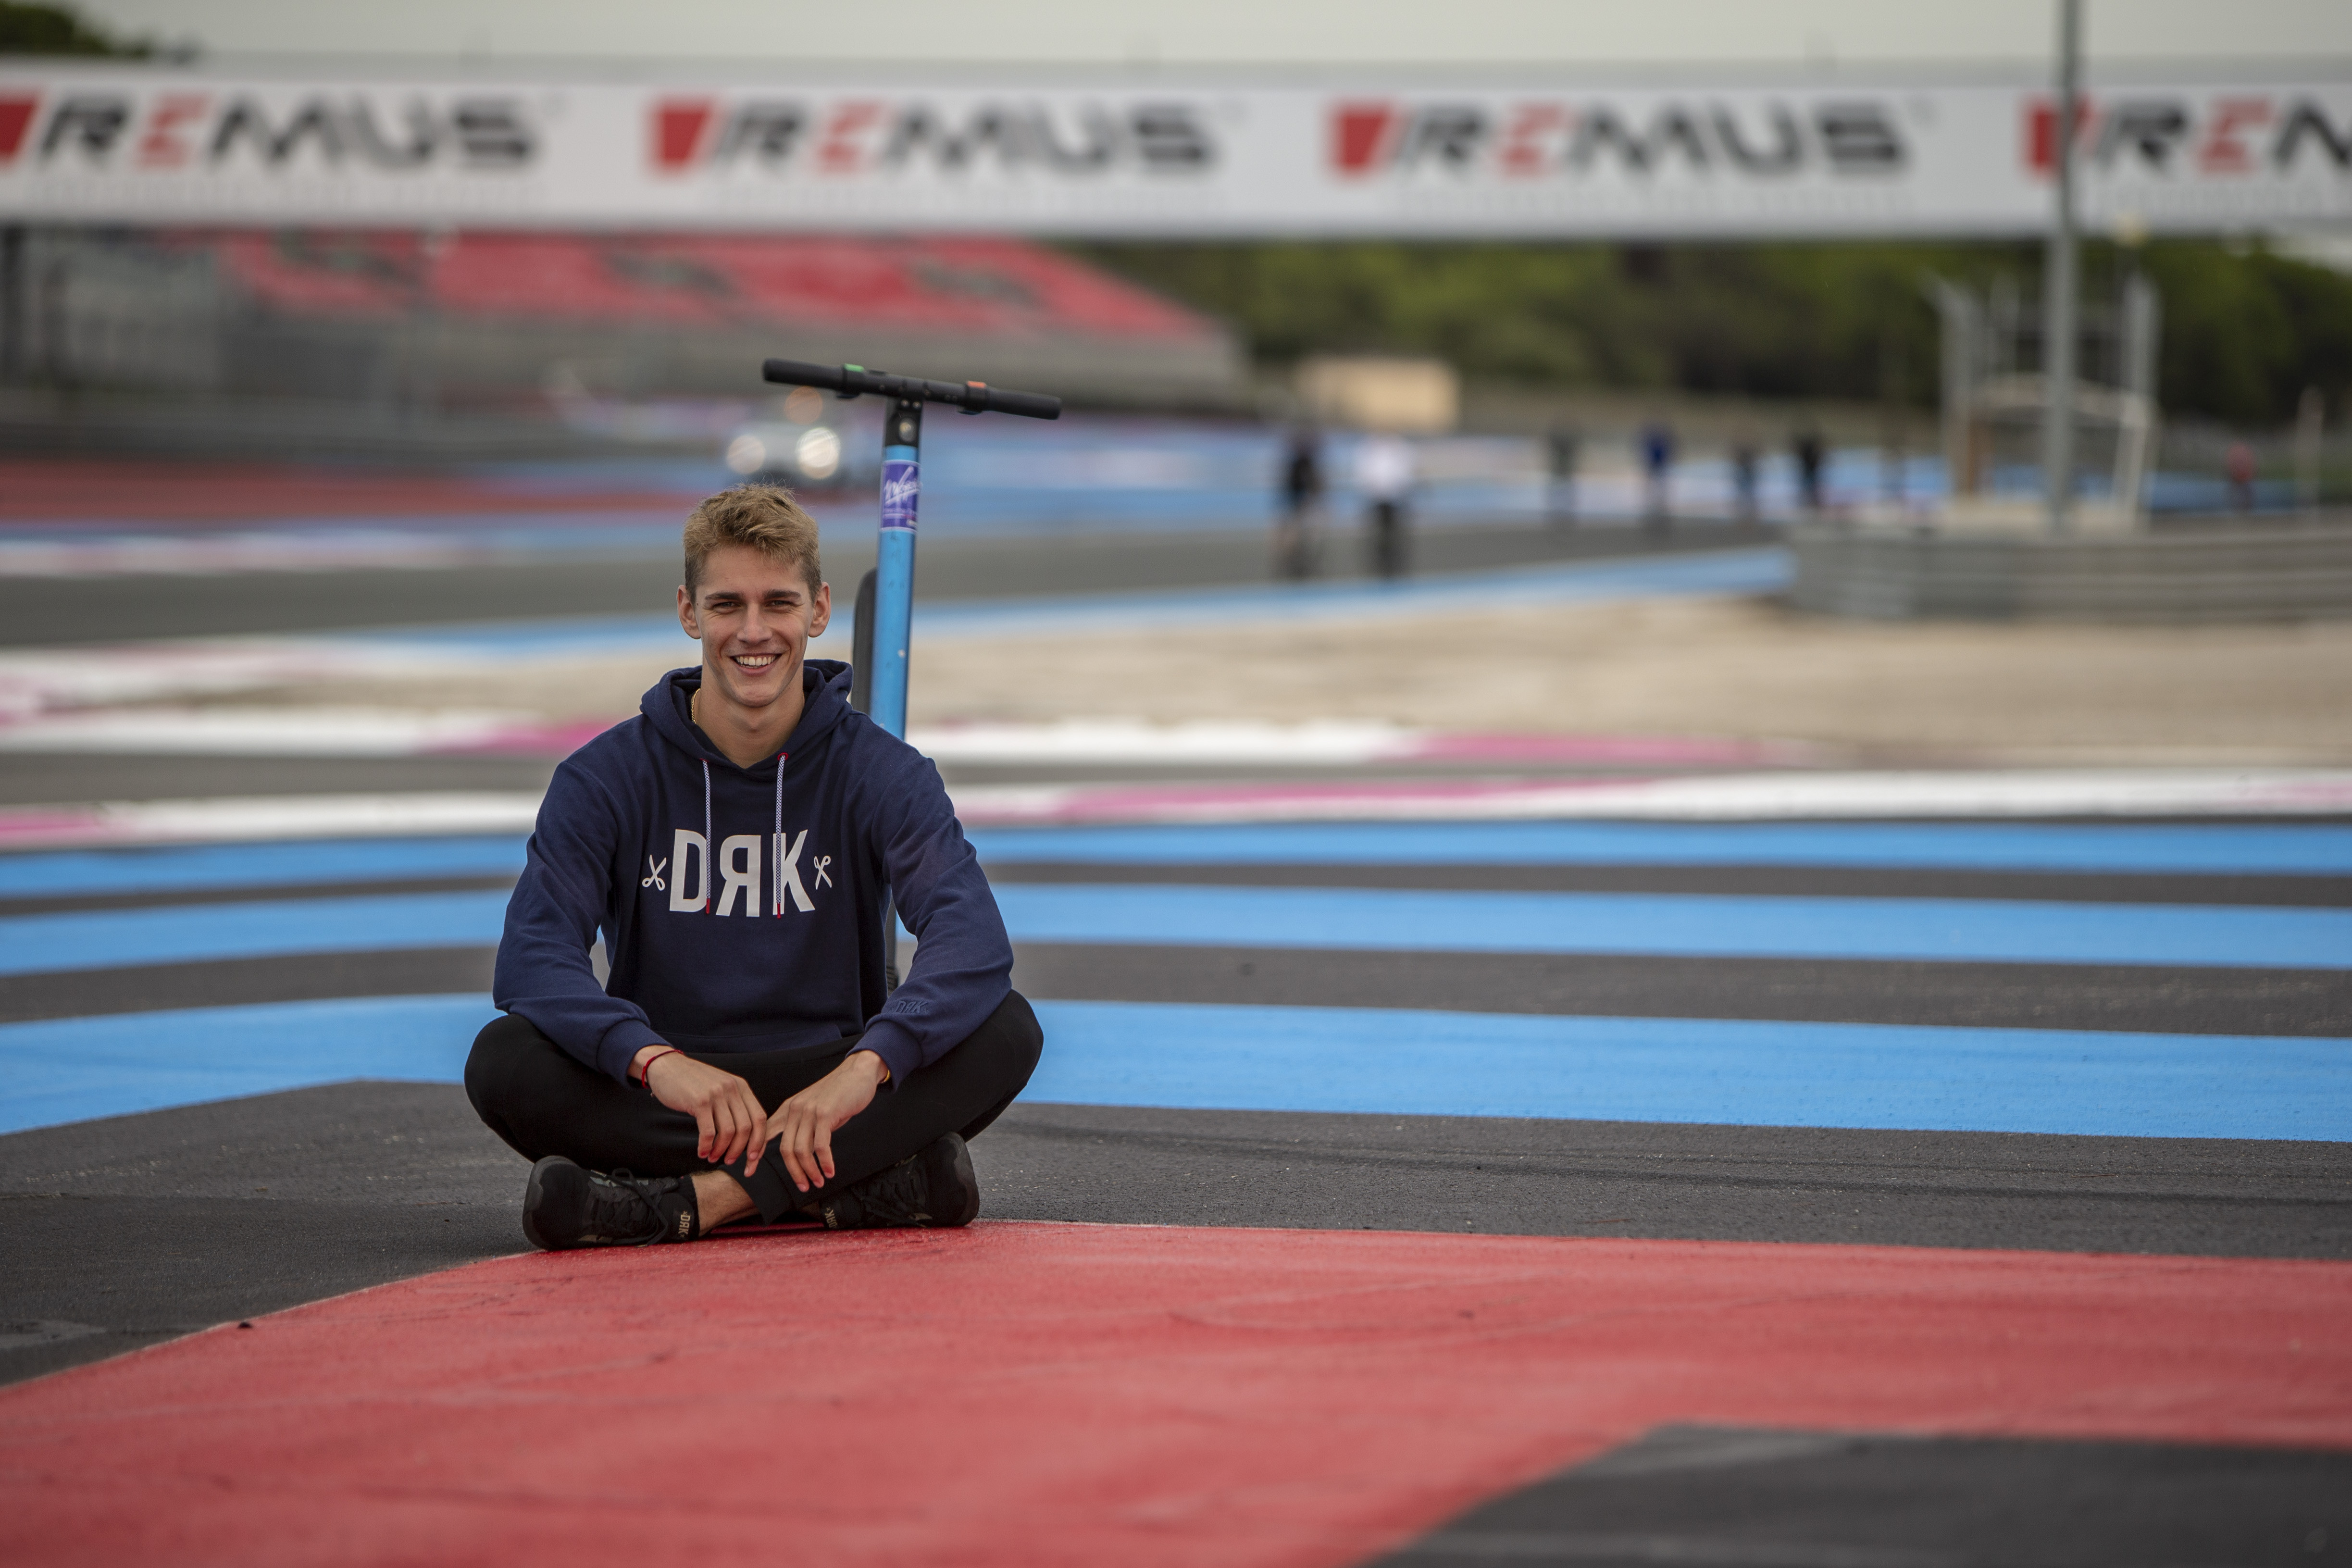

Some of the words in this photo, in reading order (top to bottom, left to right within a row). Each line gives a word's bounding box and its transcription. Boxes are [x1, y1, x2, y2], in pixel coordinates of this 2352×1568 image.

[37, 93, 537, 169] REMUS
[712, 99, 1219, 174] REMUS
[1397, 100, 1908, 175] REMUS
